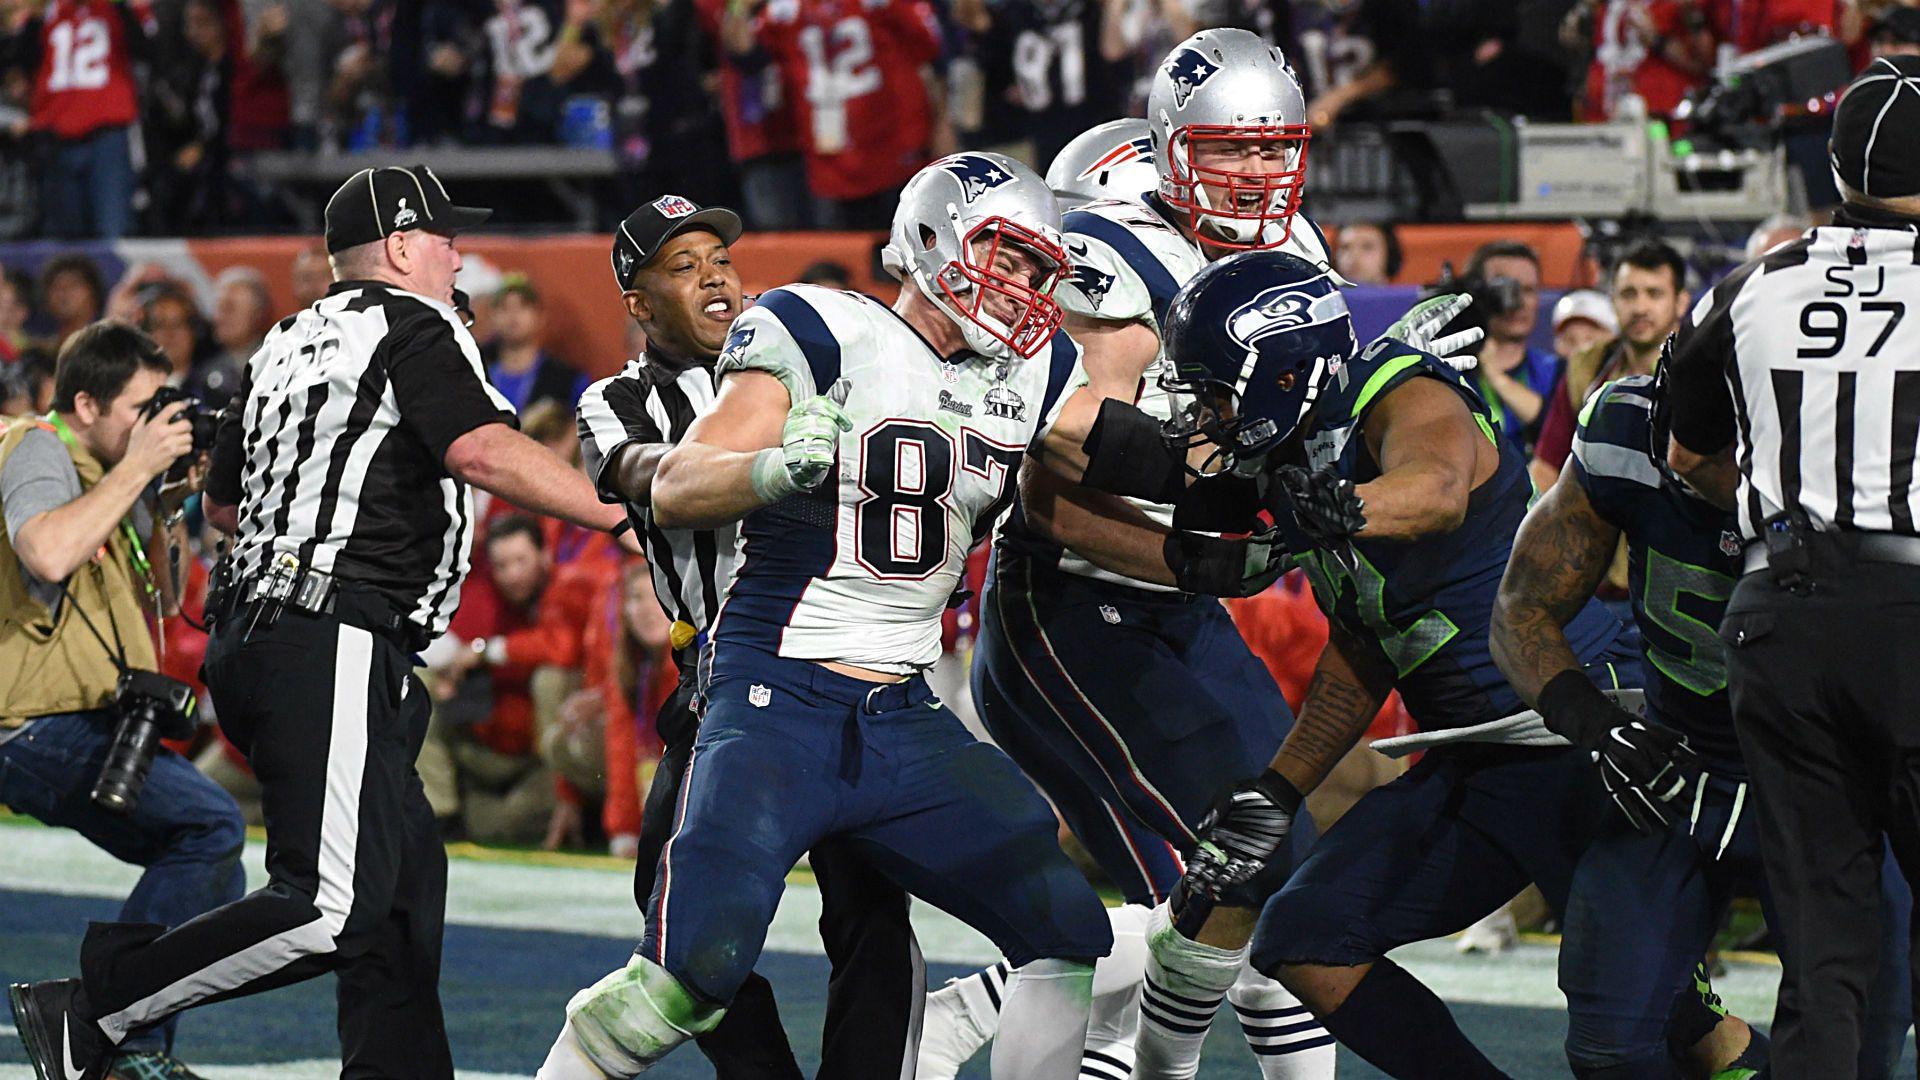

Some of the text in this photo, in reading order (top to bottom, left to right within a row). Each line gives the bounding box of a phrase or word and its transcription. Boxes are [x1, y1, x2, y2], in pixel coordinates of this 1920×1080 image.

[48, 19, 110, 91] 12
[485, 6, 556, 77] 12
[799, 17, 883, 101] 12
[1824, 266, 1884, 297] SJ
[1797, 302, 1906, 358] 97
[855, 418, 1027, 581] 87
